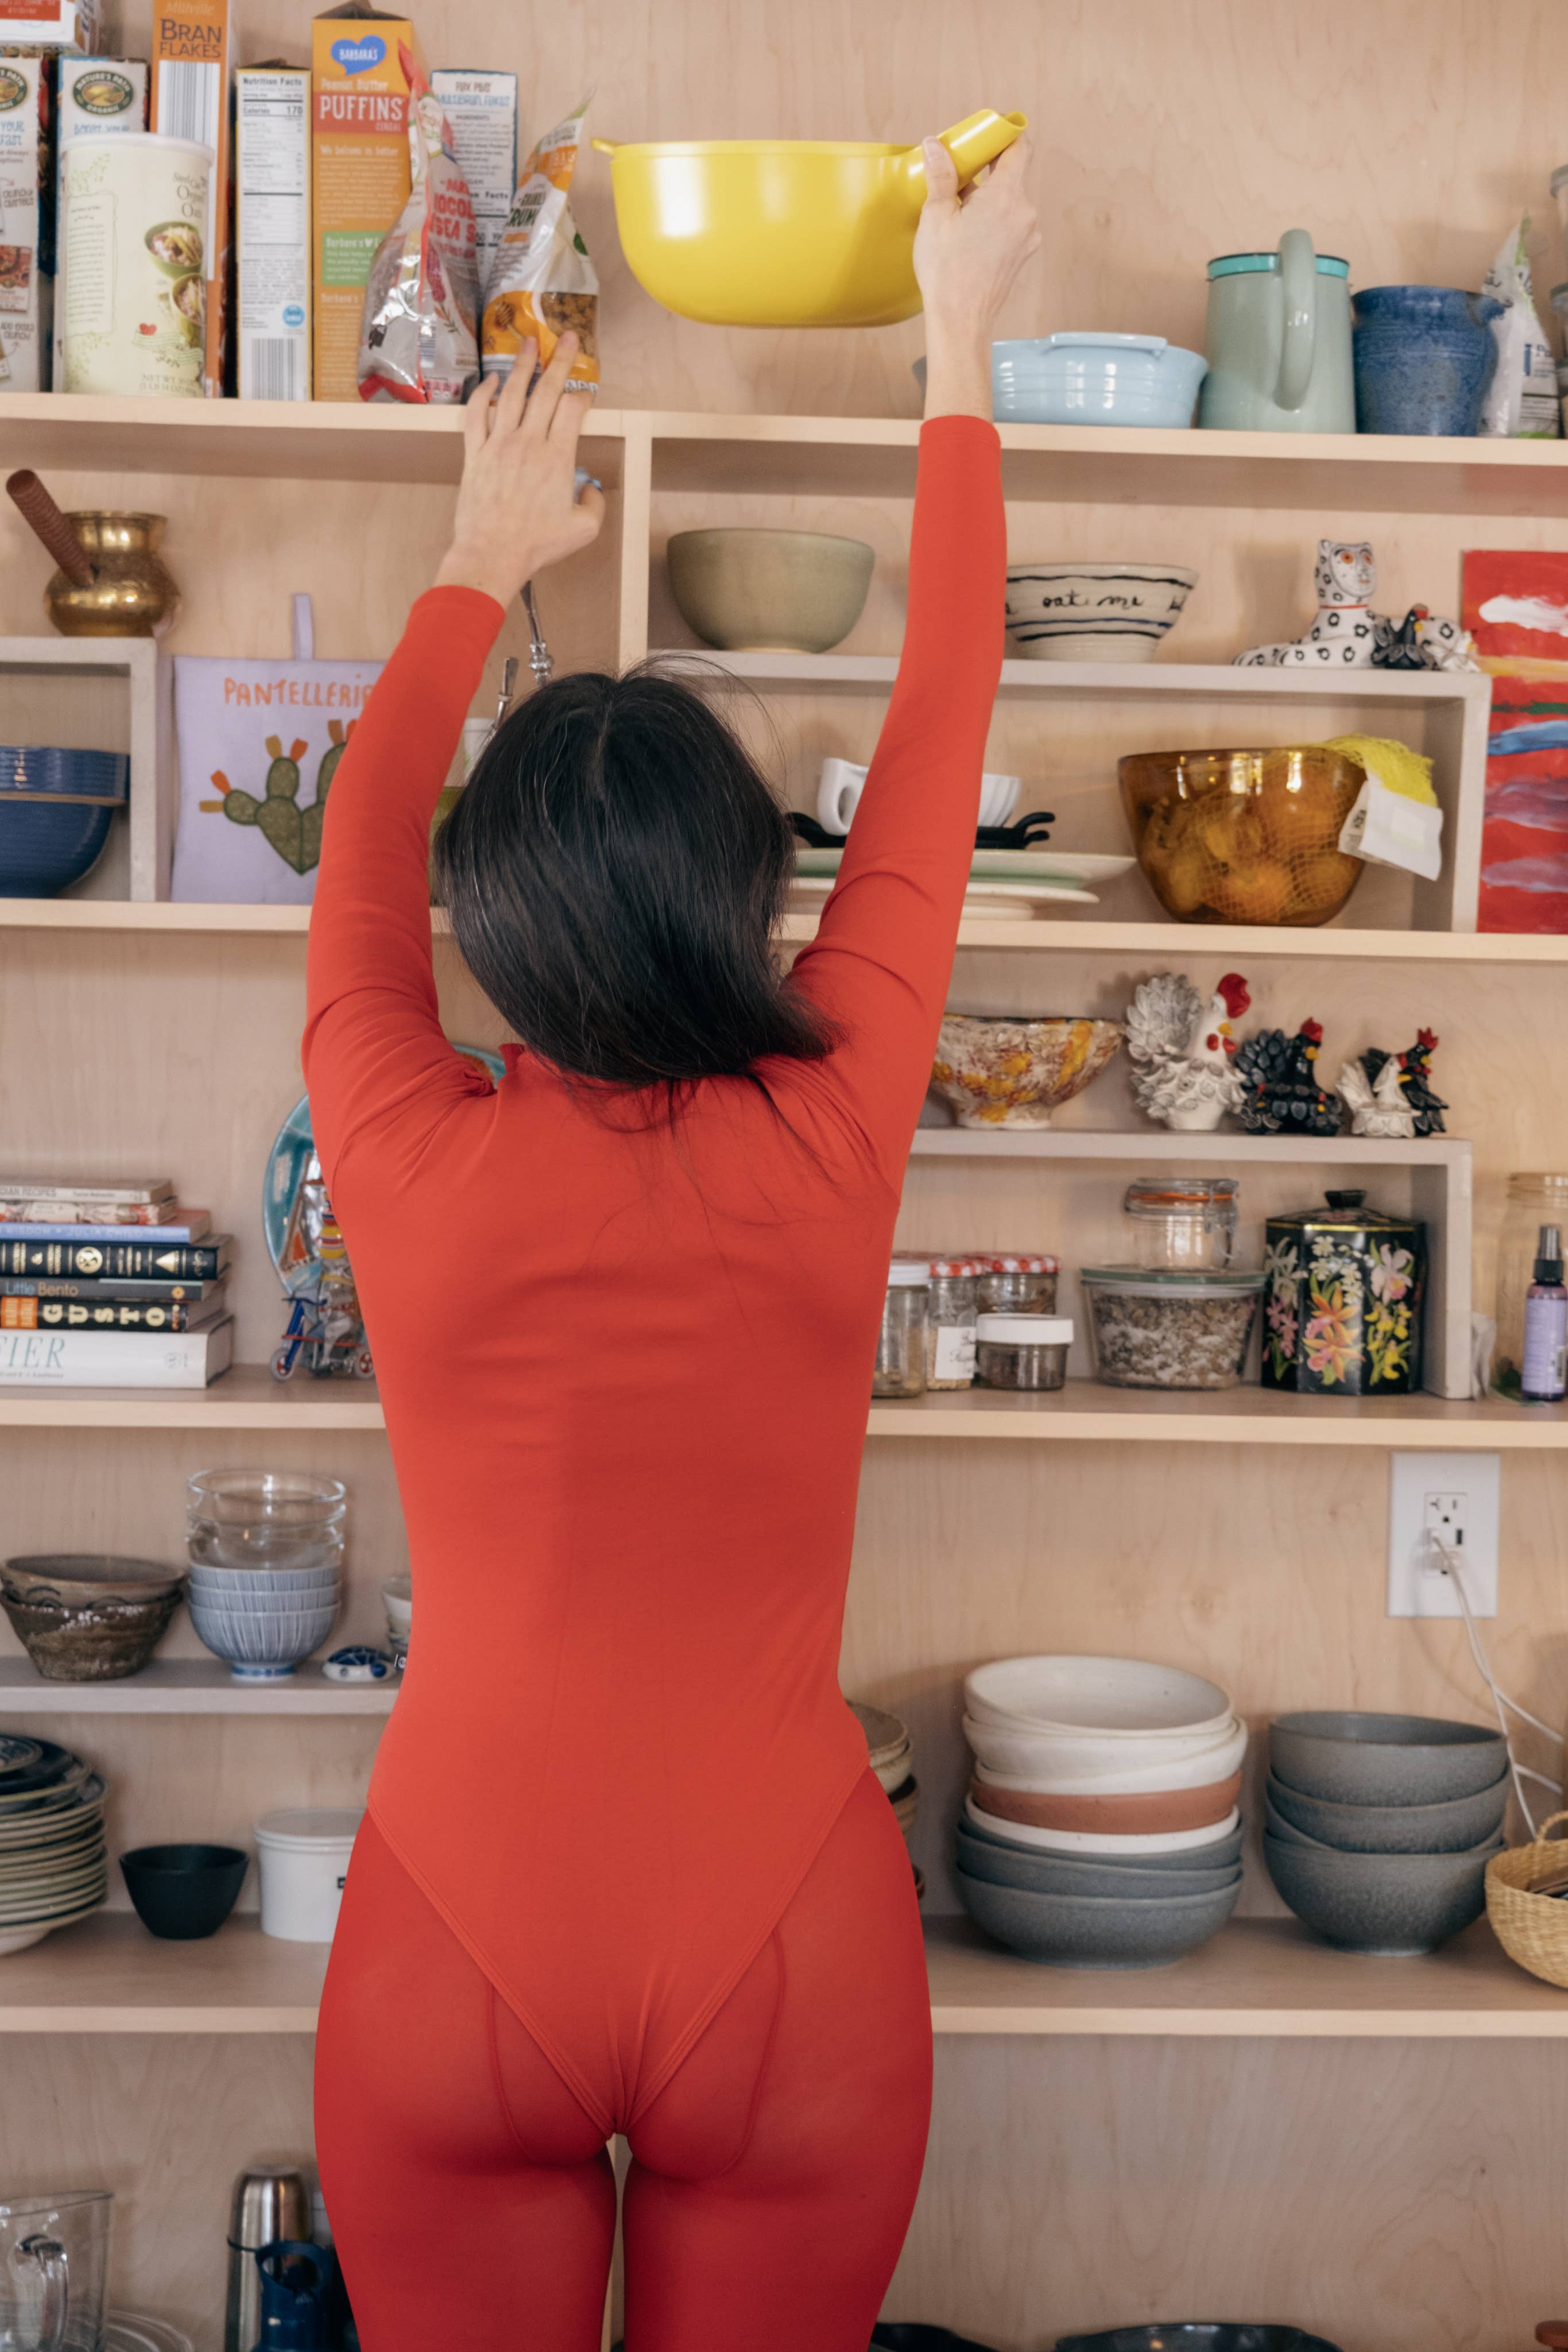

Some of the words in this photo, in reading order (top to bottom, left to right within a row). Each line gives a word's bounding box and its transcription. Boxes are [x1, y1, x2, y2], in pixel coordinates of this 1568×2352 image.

[160, 18, 222, 43] BRAN
[160, 41, 221, 58] FLAKES
[319, 95, 402, 121] PUFFINS
[5, 1281, 36, 1297] Little
[38, 1281, 79, 1298] Bento
[43, 1304, 167, 1328] GUSTO
